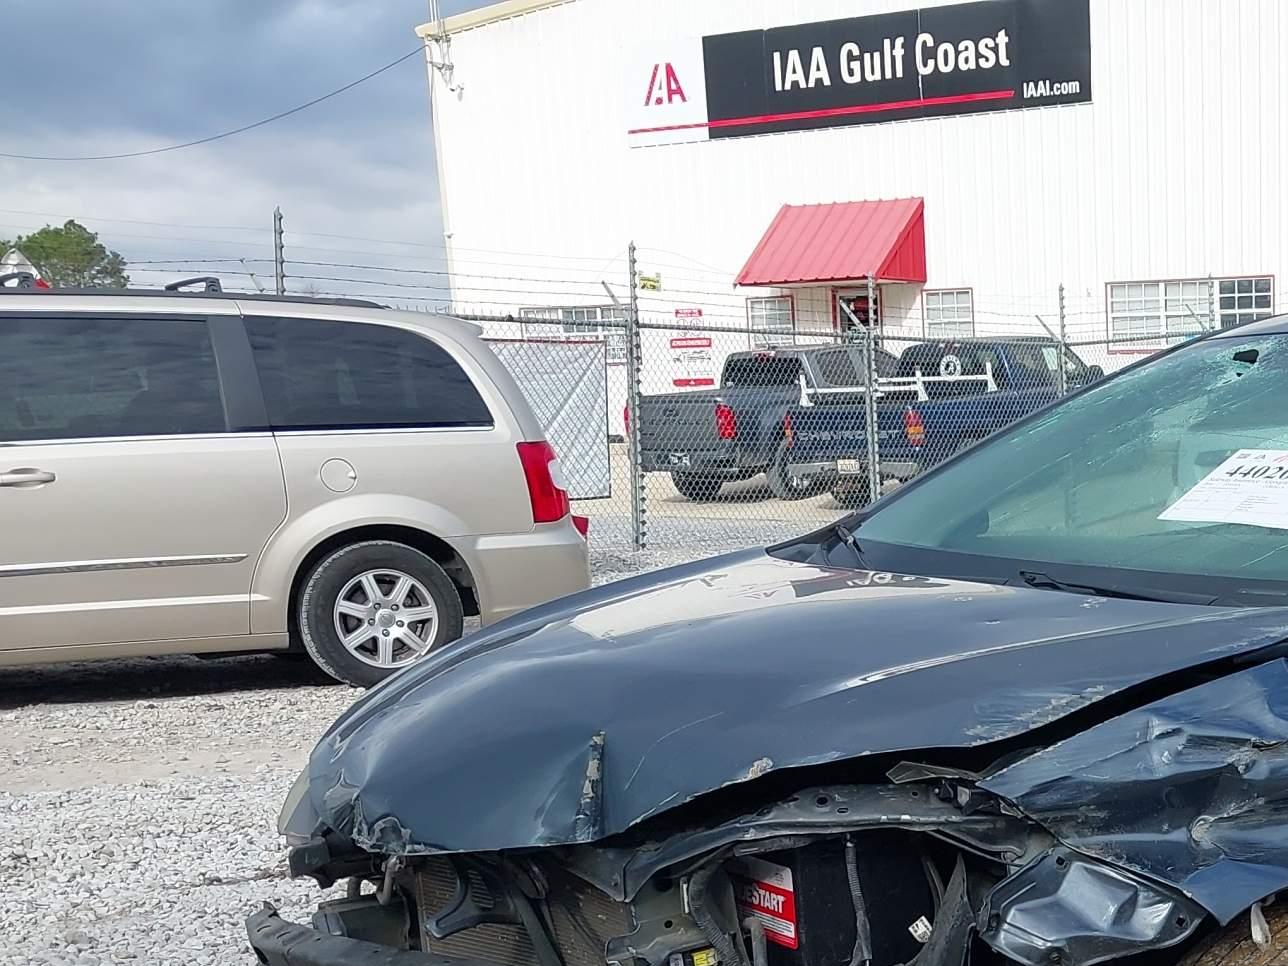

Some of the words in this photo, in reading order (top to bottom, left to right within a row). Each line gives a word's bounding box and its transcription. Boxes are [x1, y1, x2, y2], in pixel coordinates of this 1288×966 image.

[773, 46, 832, 91] IAA
[839, 36, 905, 84] Gulf
[915, 27, 1010, 76] Coast
[1023, 79, 1081, 99] IAAI.com
[797, 429, 900, 440] CHEVROET
